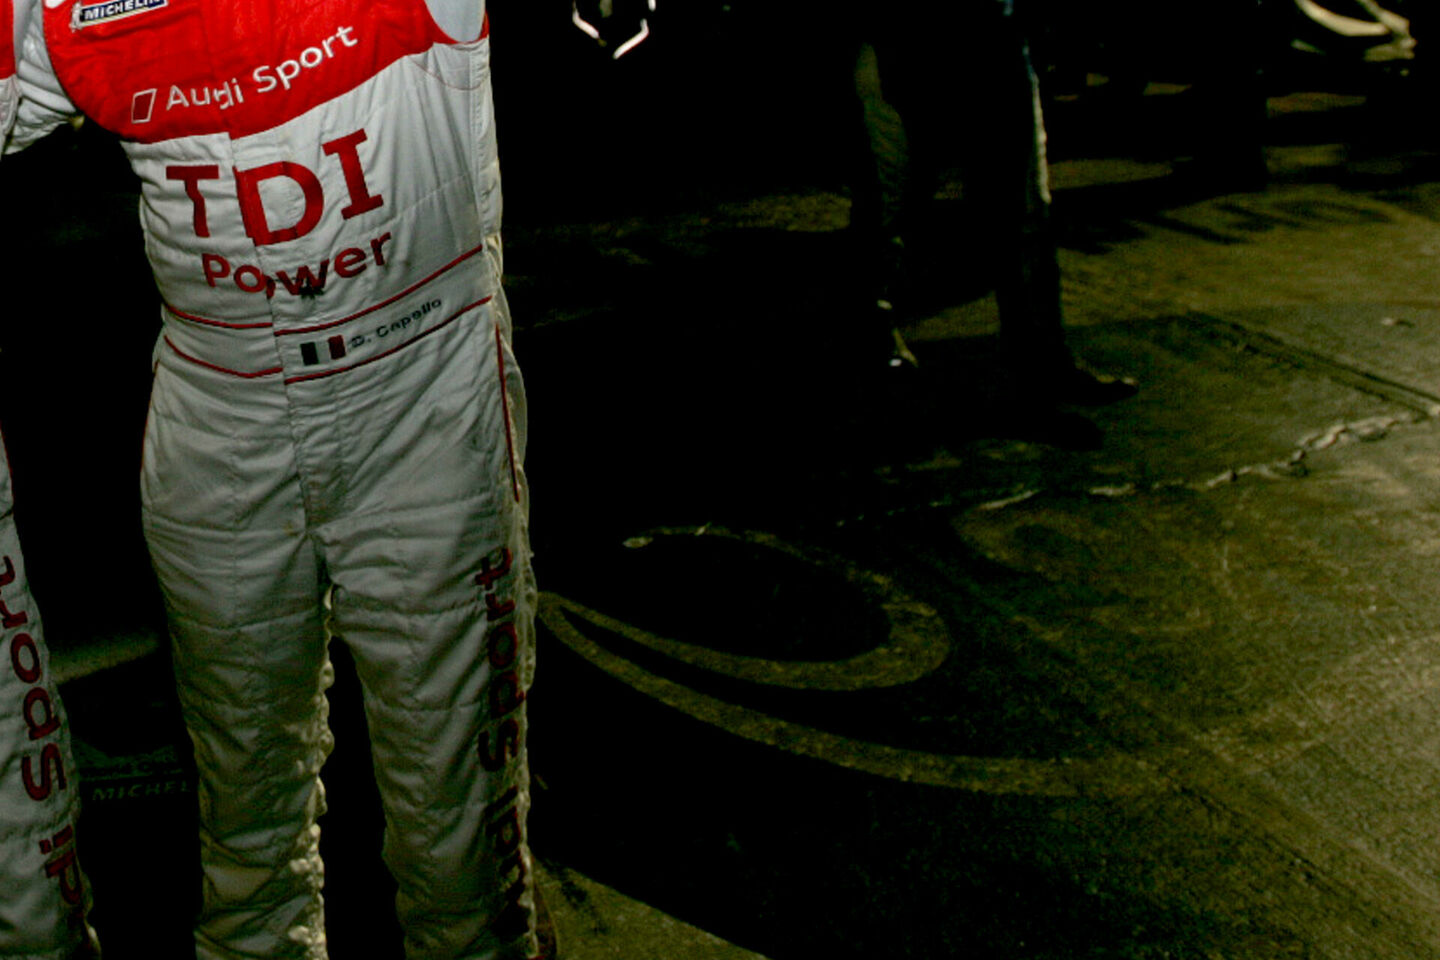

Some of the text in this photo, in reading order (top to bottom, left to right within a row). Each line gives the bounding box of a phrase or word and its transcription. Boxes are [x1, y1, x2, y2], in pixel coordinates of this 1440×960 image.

[166, 25, 358, 111] Audi Sport
[166, 128, 384, 247] TDI
[201, 232, 392, 299] Power
[474, 547, 526, 772] Sport
